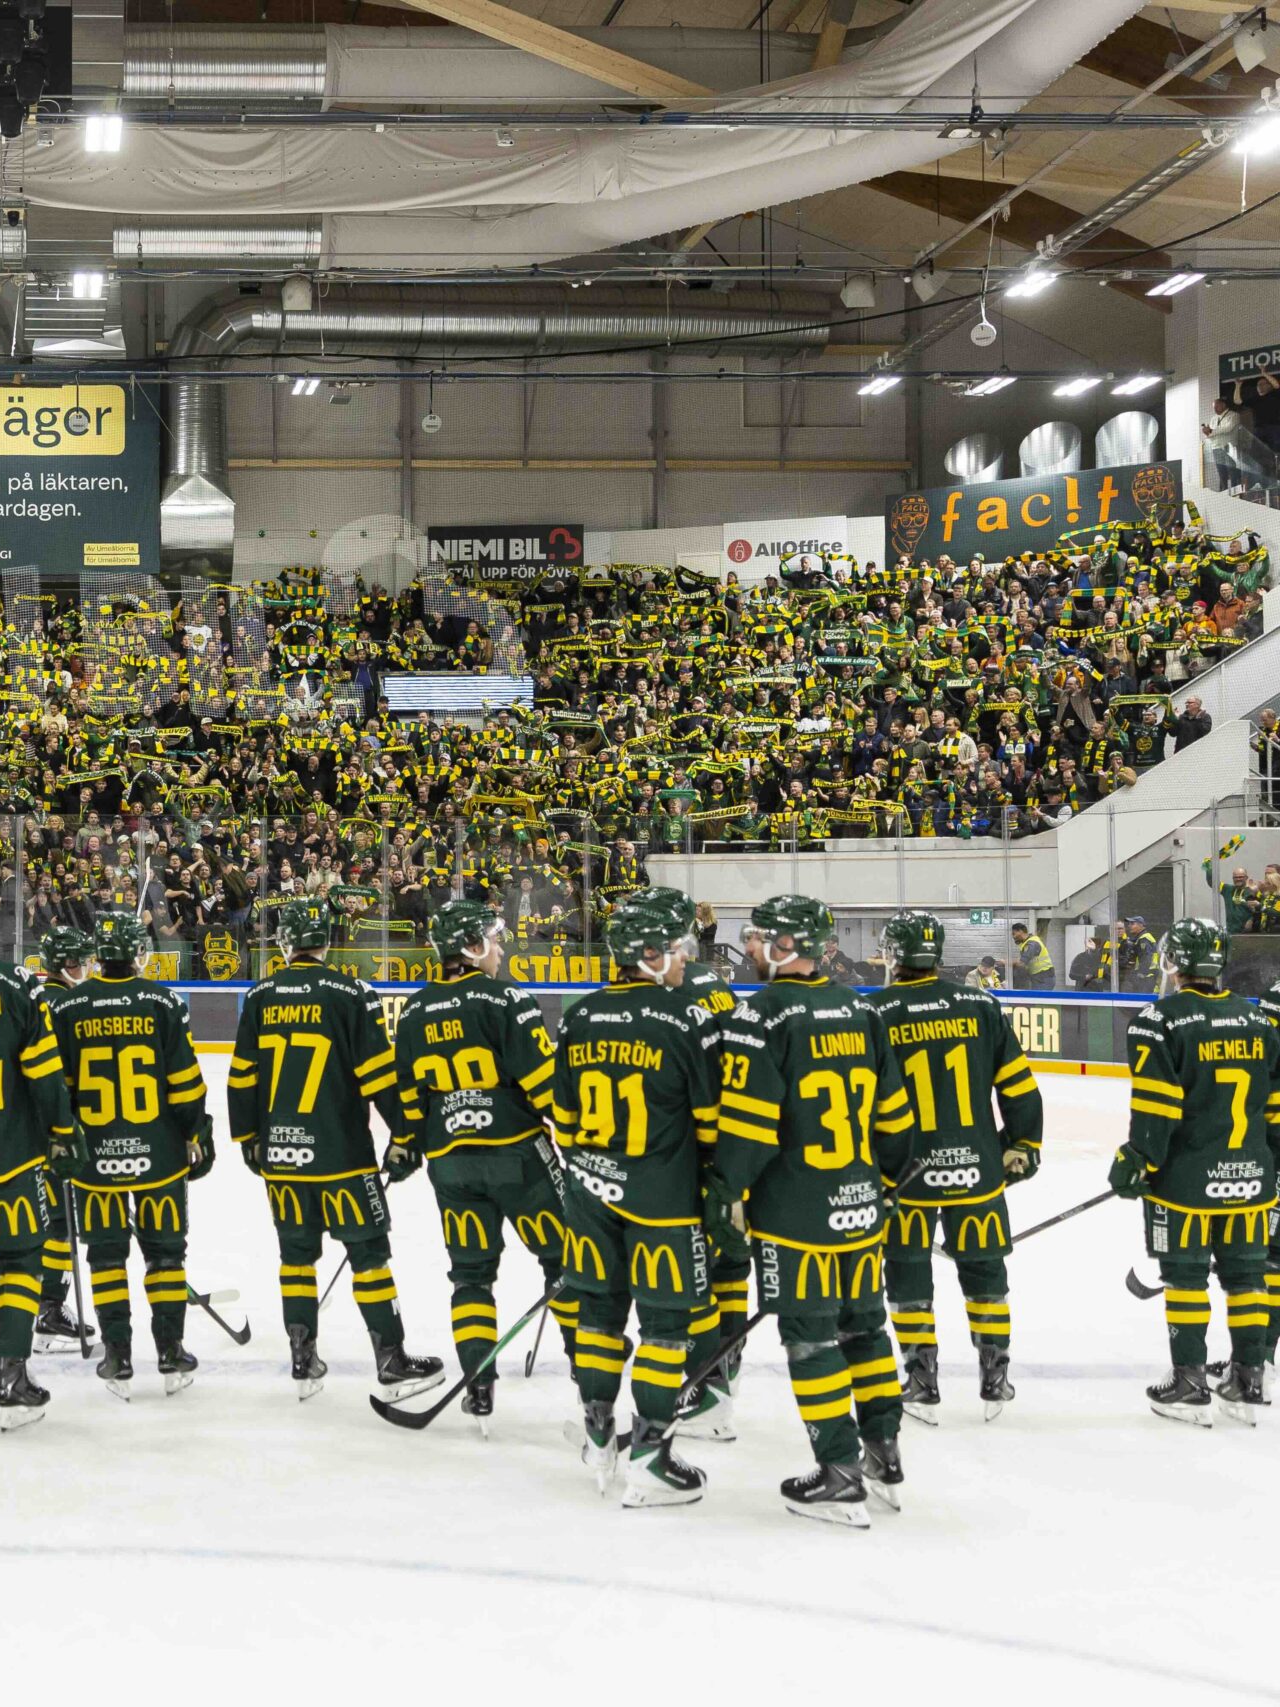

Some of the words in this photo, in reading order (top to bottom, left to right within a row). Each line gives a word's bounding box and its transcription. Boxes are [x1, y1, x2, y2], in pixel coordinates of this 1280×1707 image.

[3, 396, 112, 448] äger
[8, 473, 33, 494] på
[40, 473, 128, 493] läktaren,
[1135, 476, 1164, 488] FACIT
[902, 504, 927, 513] FACIT
[431, 538, 504, 561] NIEMI
[509, 538, 547, 560] BIL
[755, 538, 843, 557] AllOffice
[482, 567, 507, 579] UPP
[511, 564, 536, 579] FÖR
[263, 1004, 322, 1025] HEMMYR
[75, 1016, 155, 1040] FORSBERG
[425, 1019, 464, 1044] ALBA
[890, 1018, 978, 1046] REUNANEN
[811, 1033, 866, 1059] LUNDIN
[1199, 1037, 1264, 1062] NIEMELÄ
[1135, 1045, 1150, 1073] 7
[258, 1032, 332, 1114] 77
[78, 1044, 160, 1126] 56
[904, 1043, 974, 1132] 11
[444, 1088, 483, 1104] NORDIC
[575, 1070, 648, 1157] 91
[1215, 1068, 1251, 1149] 7
[94, 1144, 151, 1157] WELLNESS
[102, 1136, 141, 1148] NORDIC
[931, 1146, 972, 1158] NORDIC
[96, 1156, 152, 1177] coop
[921, 1154, 980, 1166] WELLNESS
[1217, 1160, 1256, 1171] NORDIC
[923, 1167, 980, 1188] coop
[1207, 1167, 1264, 1179] WELLNESS
[828, 1191, 878, 1207] WELLNESS
[838, 1182, 873, 1195] NORDIC
[1205, 1180, 1262, 1200] coop
[828, 1205, 878, 1231] coop
